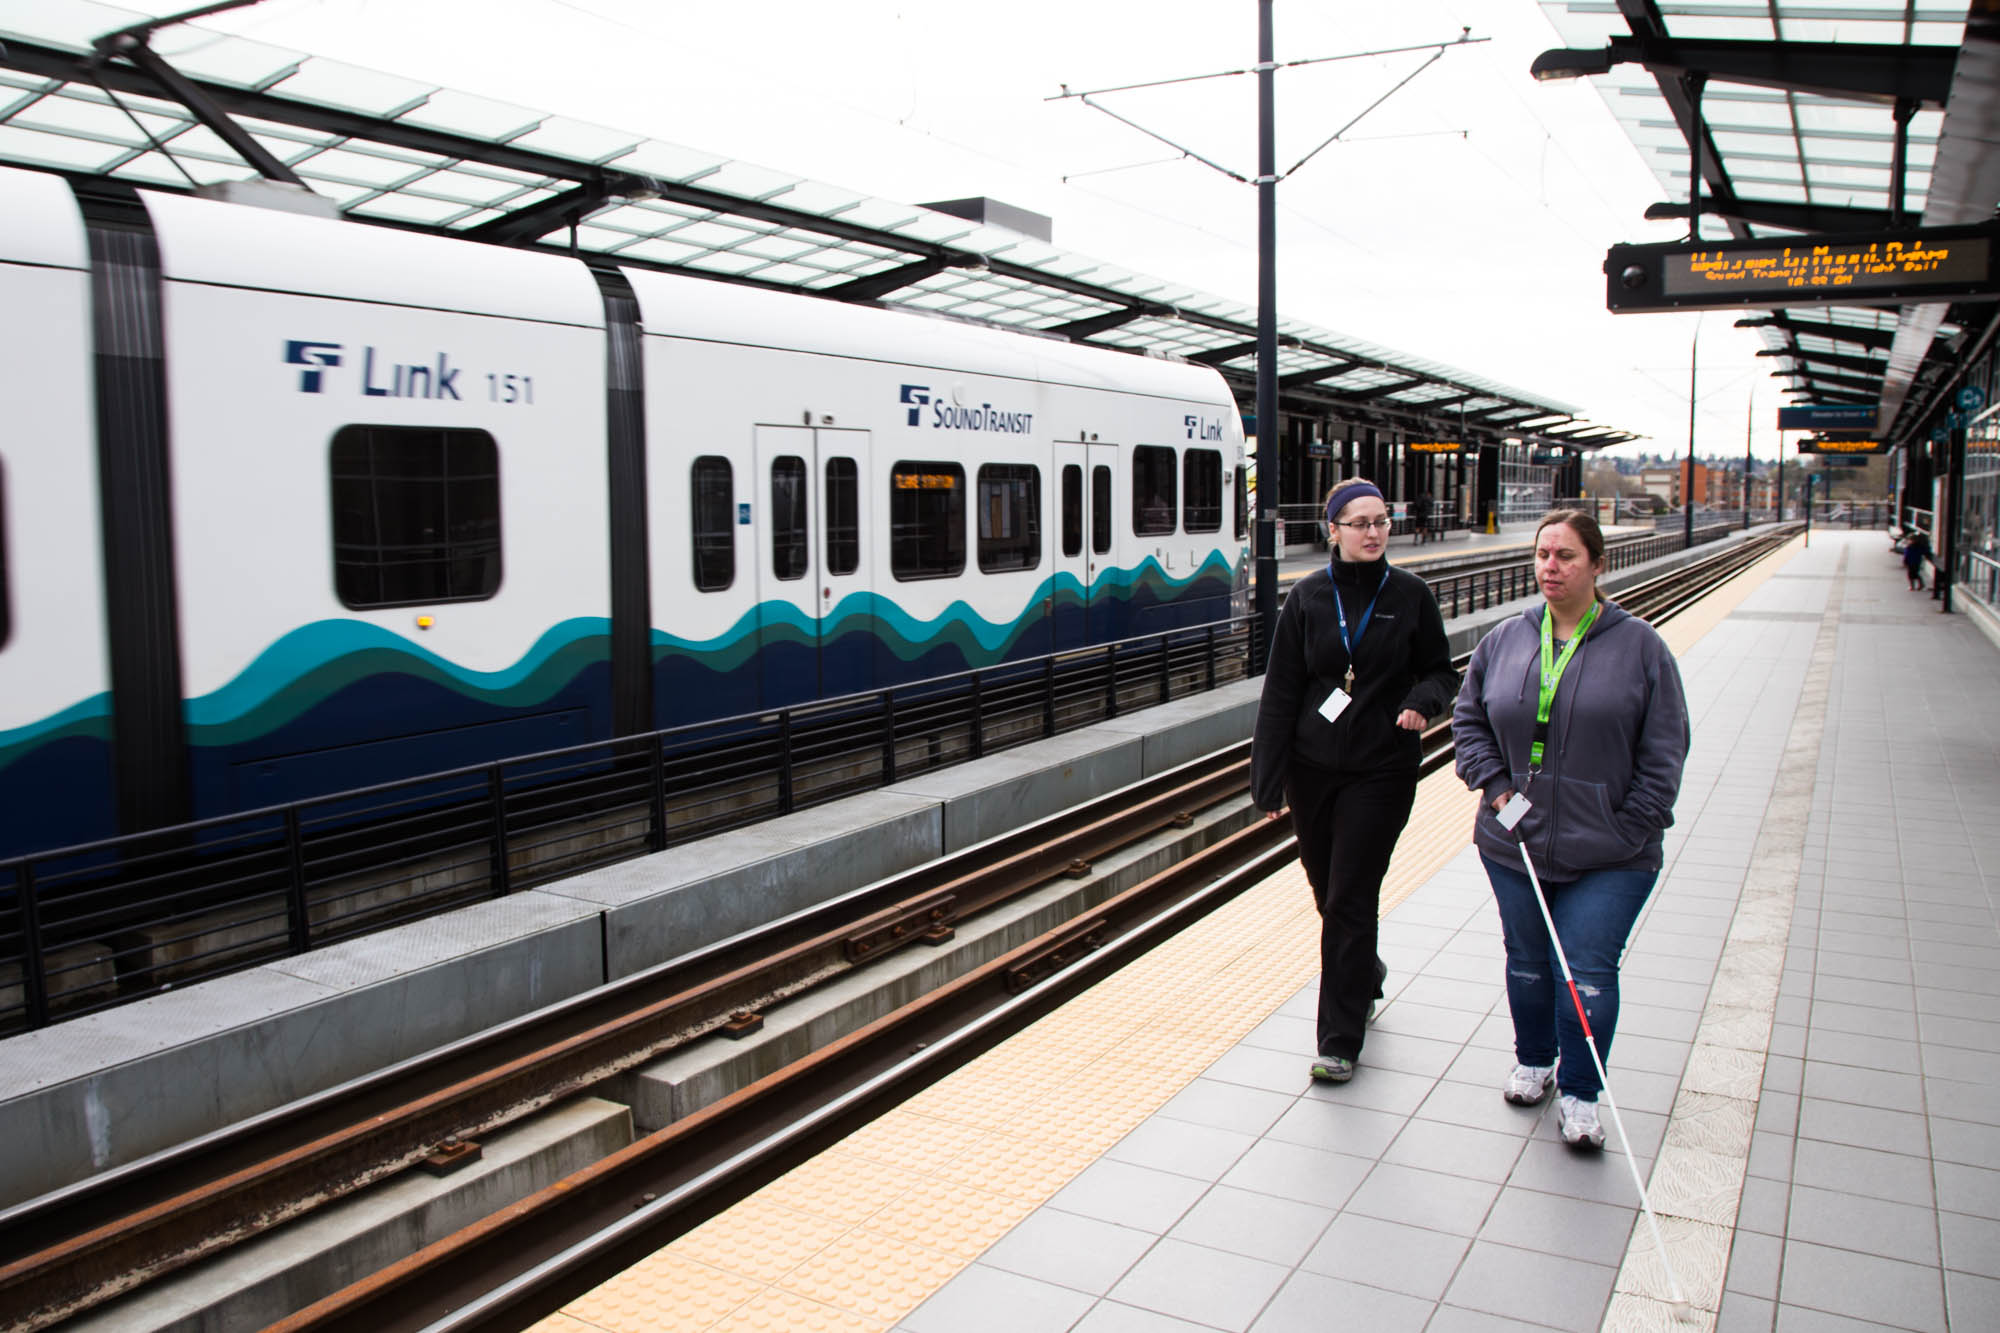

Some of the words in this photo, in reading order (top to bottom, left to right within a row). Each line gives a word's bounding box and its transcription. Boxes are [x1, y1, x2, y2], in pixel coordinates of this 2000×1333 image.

[361, 345, 462, 401] Link
[484, 372, 534, 404] 151
[1200, 417, 1224, 442] Link
